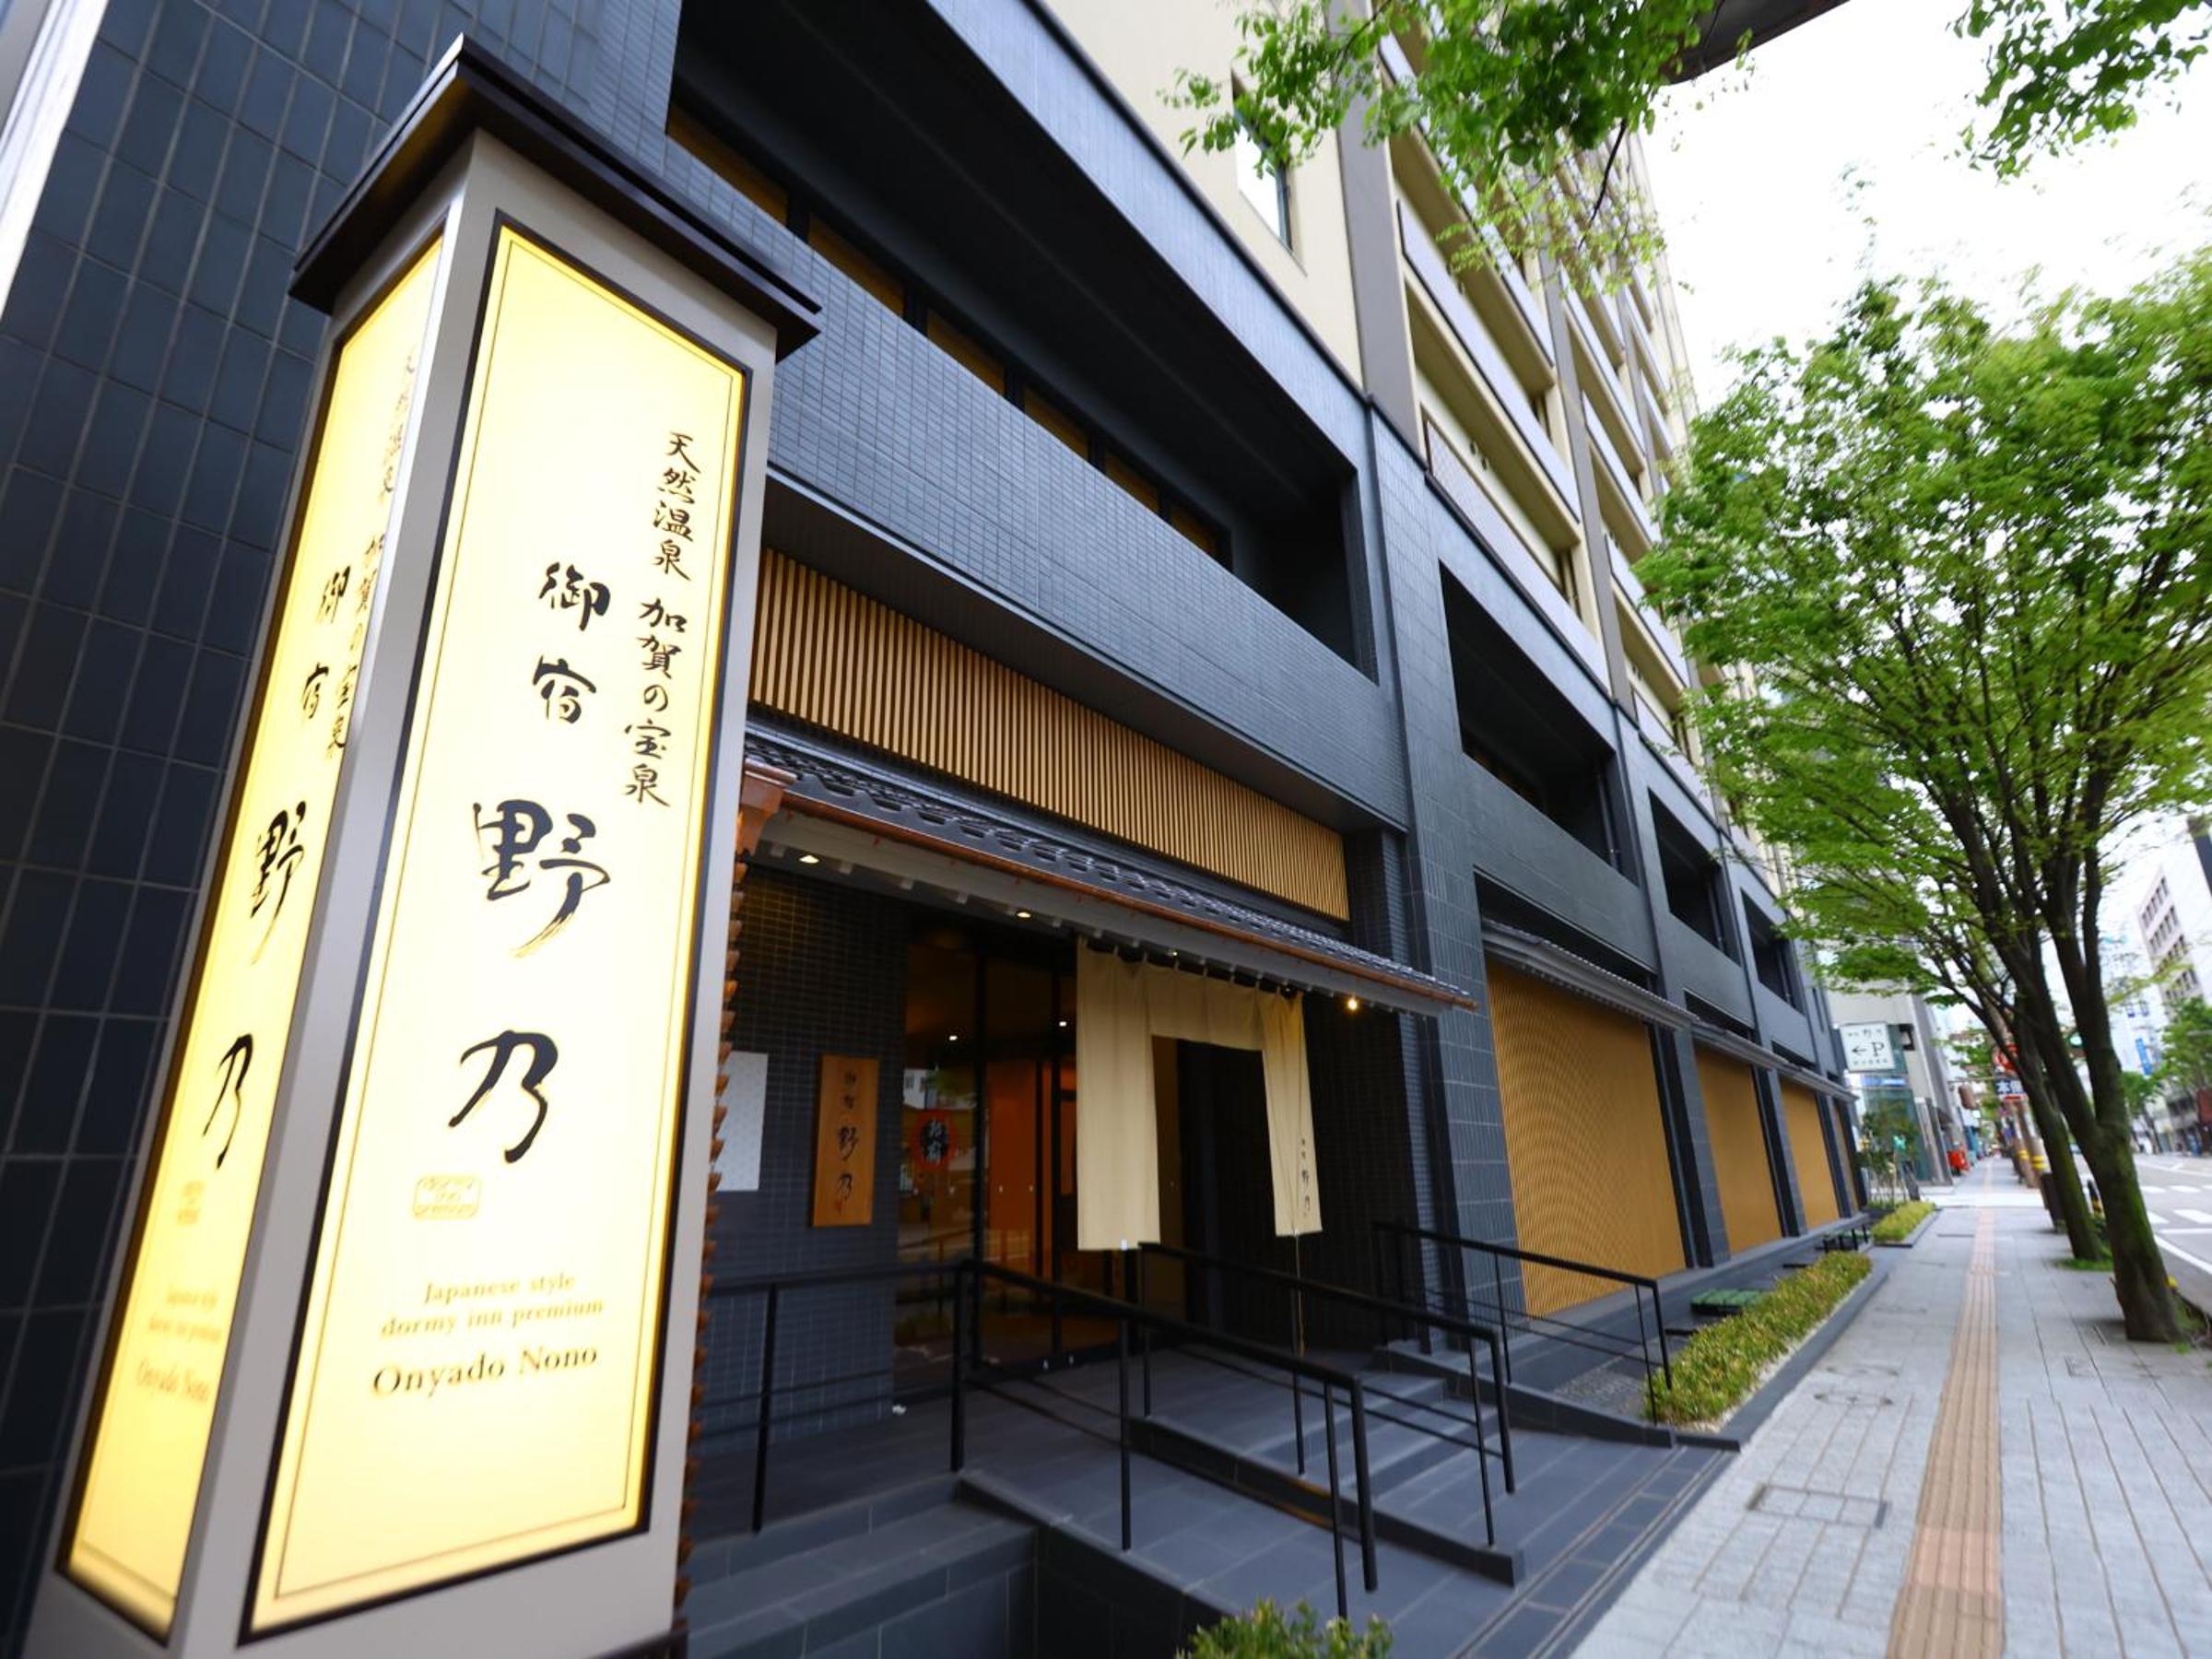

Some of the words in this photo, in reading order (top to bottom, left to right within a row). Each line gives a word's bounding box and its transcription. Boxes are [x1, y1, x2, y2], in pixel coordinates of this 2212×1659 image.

[652, 431, 701, 582] 天然温泉
[624, 596, 688, 807] 加賀の宝泉
[1870, 1041, 1886, 1057] P
[424, 1280, 519, 1305] Japanese
[530, 1272, 574, 1296] style
[381, 1315, 456, 1336] dormy
[467, 1310, 502, 1327] inn
[512, 1300, 605, 1328] premium
[373, 1351, 505, 1398] Onyado
[518, 1345, 598, 1375] Nono
